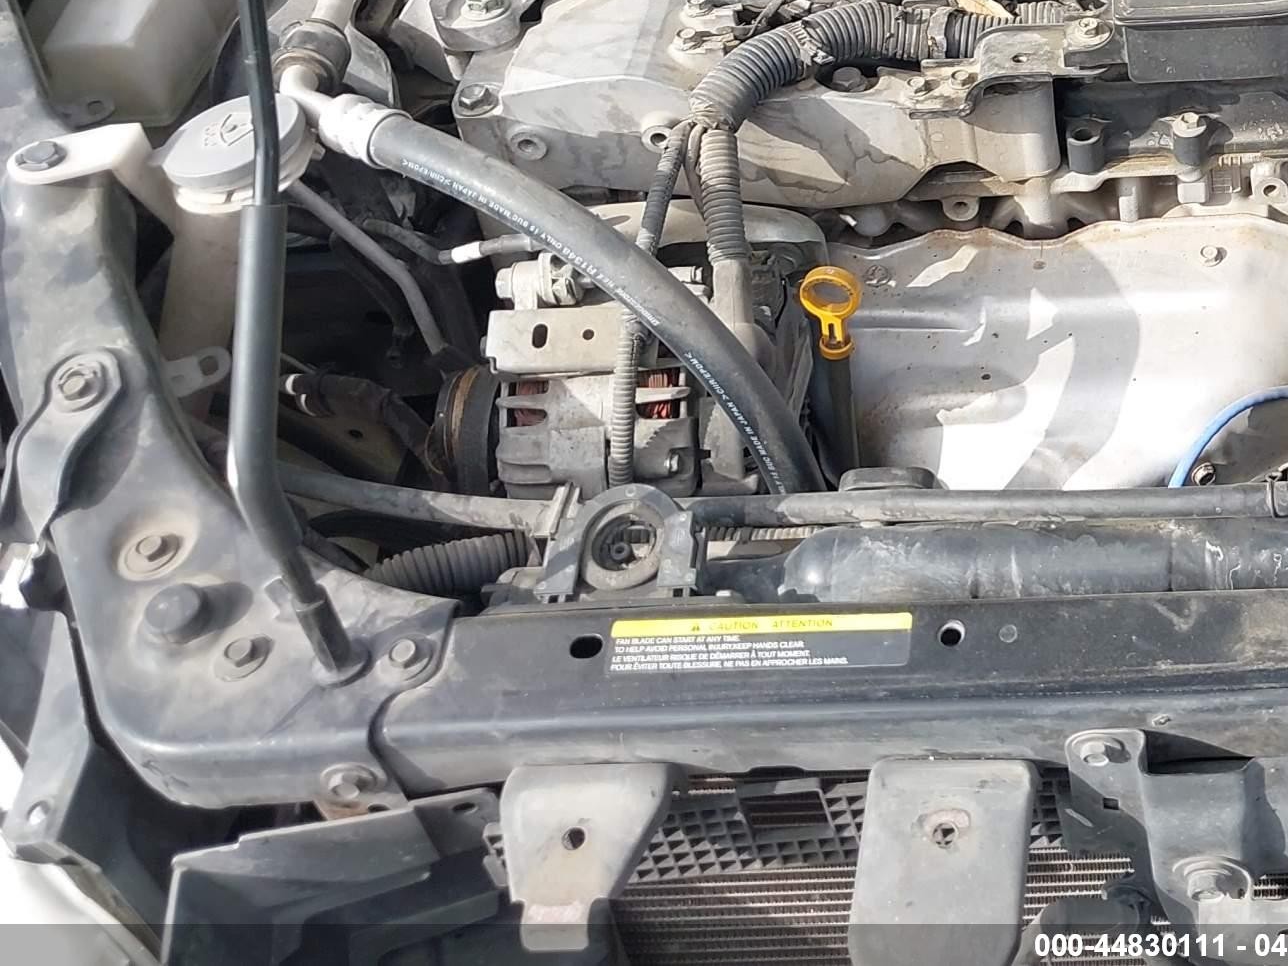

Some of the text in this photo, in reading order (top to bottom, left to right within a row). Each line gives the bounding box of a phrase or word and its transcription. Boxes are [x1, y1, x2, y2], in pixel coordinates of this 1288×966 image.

[450, 180, 478, 200] JAPAN
[477, 194, 488, 204] IN
[726, 399, 749, 428] JAPAN
[743, 424, 755, 437] IN
[749, 434, 769, 458] MADE
[709, 619, 833, 631] CAUTION ATTENTION
[631, 637, 655, 645] BLADE
[673, 636, 696, 644] START
[645, 645, 668, 653] AVOID
[668, 644, 707, 652] PERSONAL
[623, 654, 669, 662] VENTILATEUR
[670, 653, 698, 661] RISQUE
[758, 650, 777, 658] TOUT
[610, 663, 633, 671] POUR
[659, 662, 682, 670] TOUTE
[750, 659, 761, 667] EN
[762, 658, 808, 666] APPROCHER
